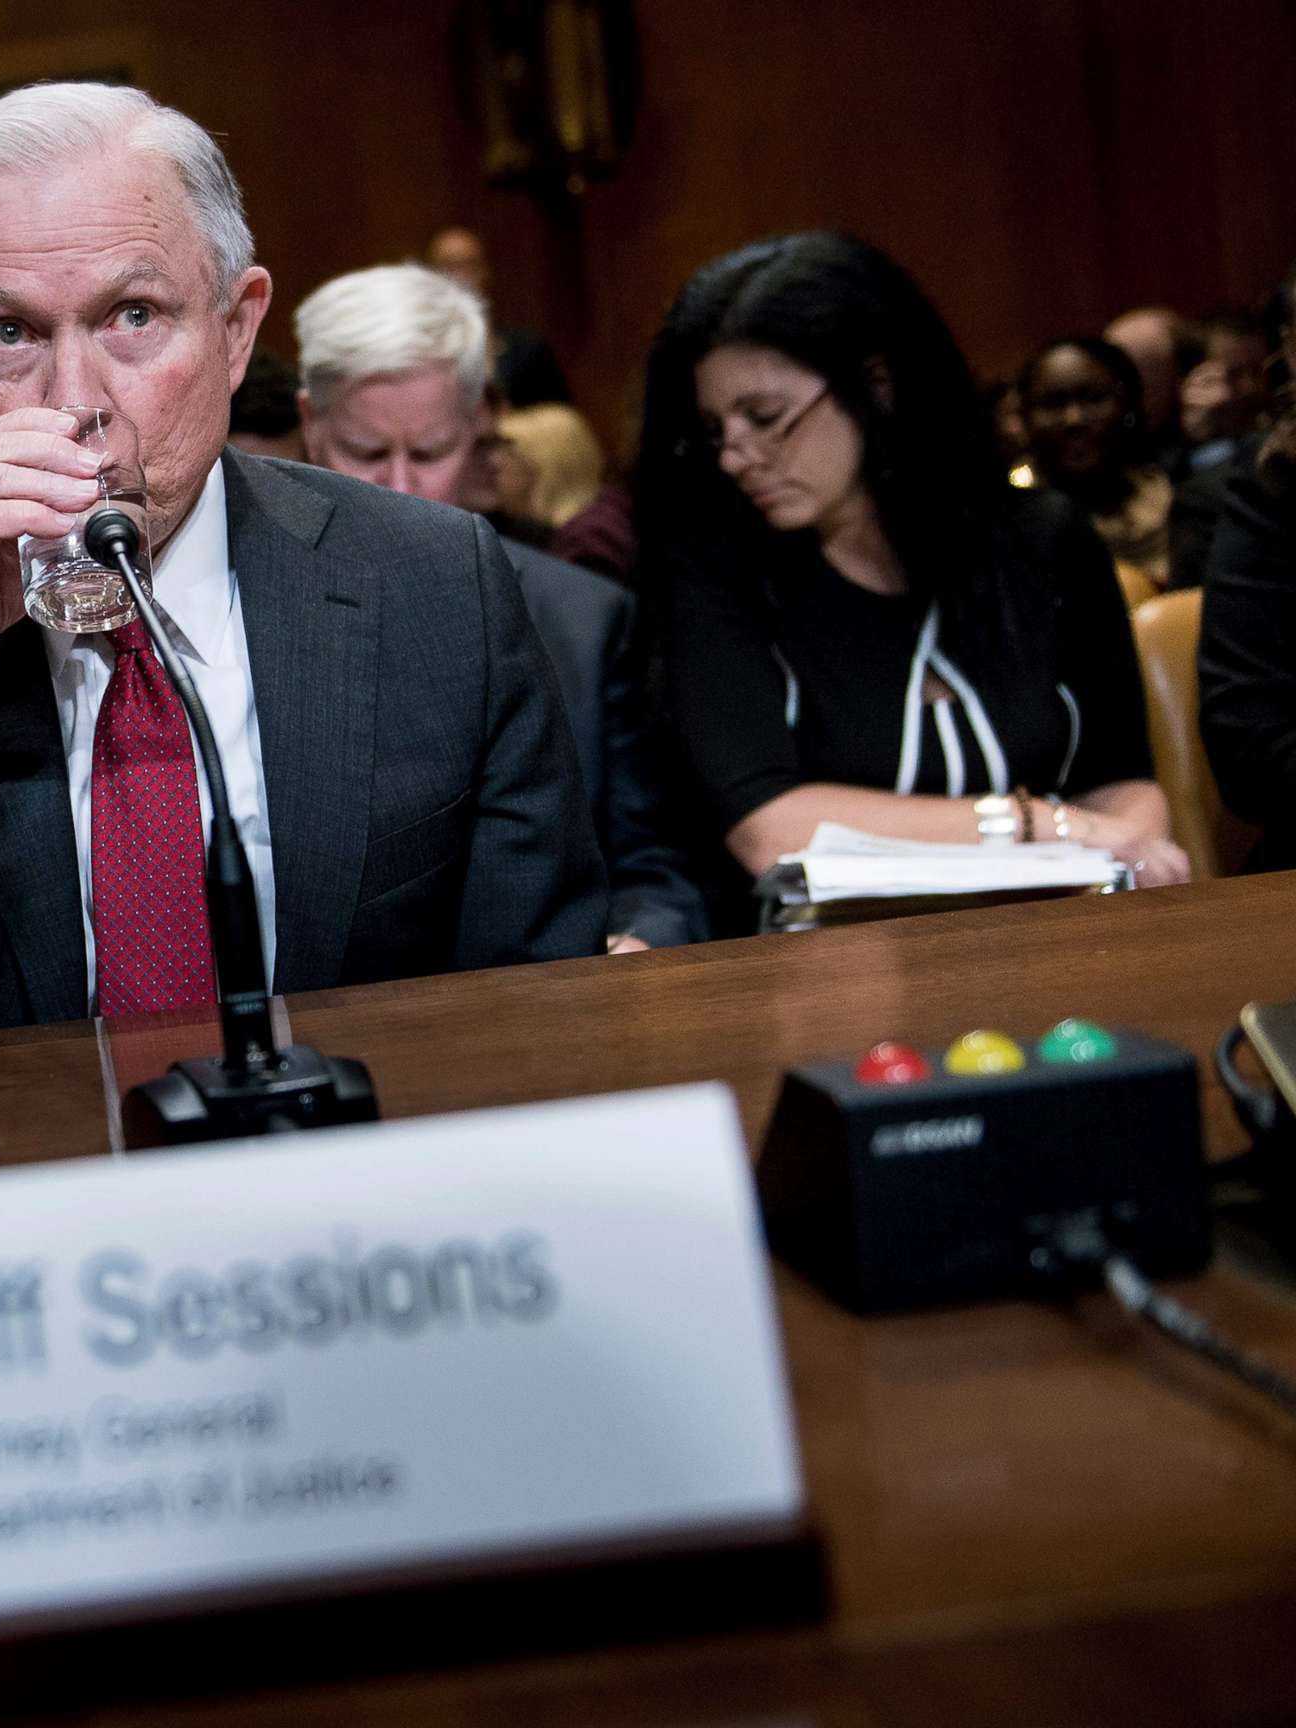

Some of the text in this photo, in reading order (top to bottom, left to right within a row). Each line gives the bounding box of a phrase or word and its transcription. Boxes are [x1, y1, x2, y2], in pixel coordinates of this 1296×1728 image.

[80, 1224, 558, 1368] Sessions
[90, 1392, 284, 1458] General
[241, 1450, 404, 1520] Justice
